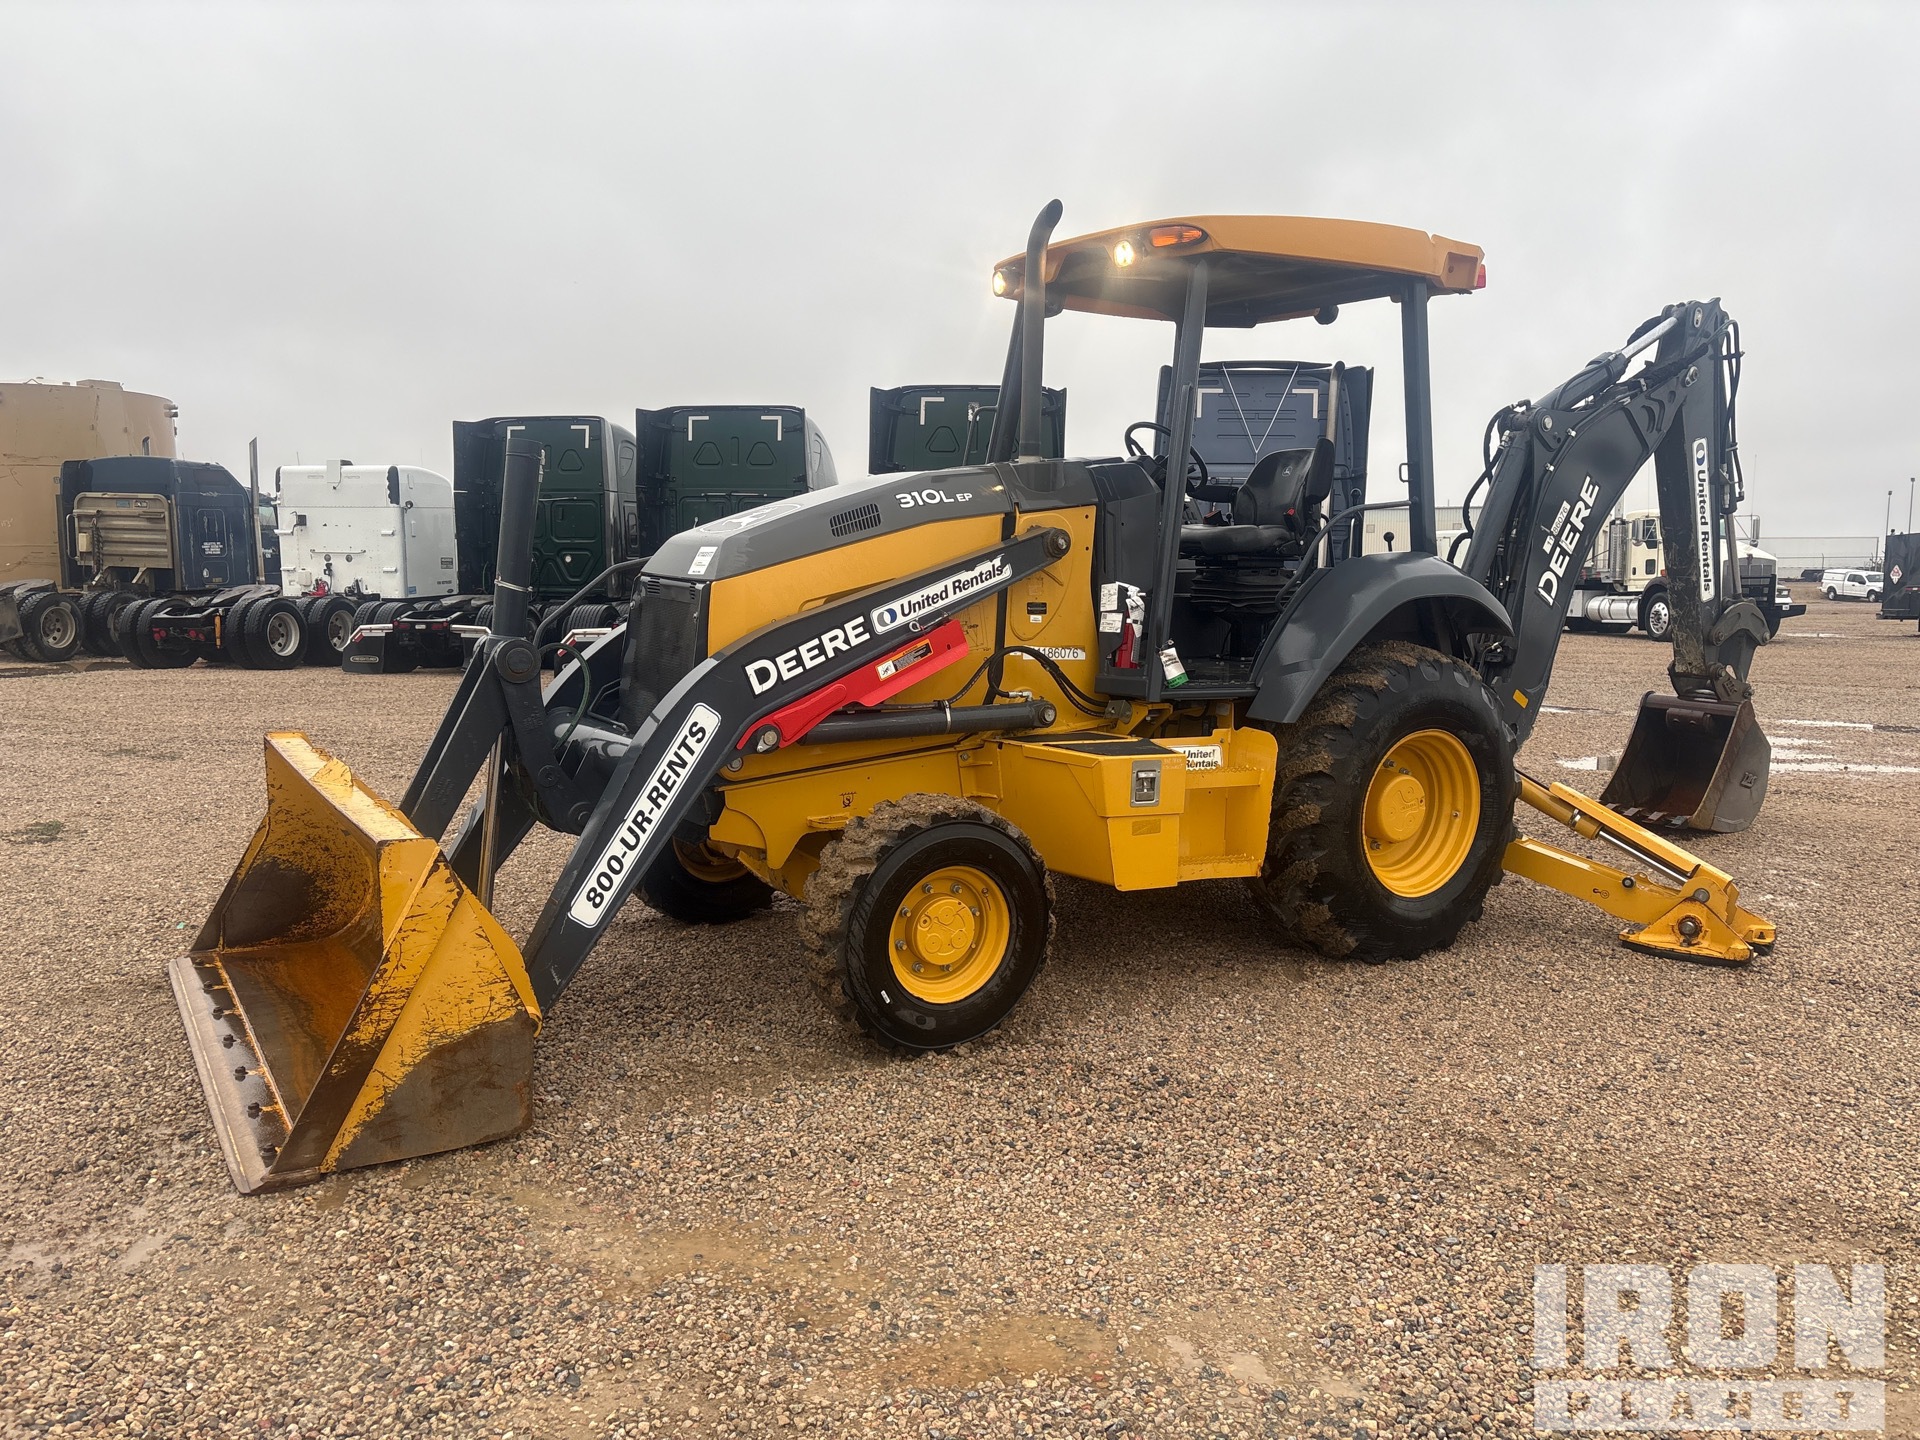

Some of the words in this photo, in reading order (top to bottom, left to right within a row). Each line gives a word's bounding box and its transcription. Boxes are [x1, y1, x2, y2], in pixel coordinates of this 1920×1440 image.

[895, 489, 955, 508] 310L
[956, 493, 973, 502] EP
[1537, 475, 1600, 606] DEERE
[1697, 469, 1709, 526] United
[1700, 531, 1712, 592] Rentals
[744, 615, 871, 696] DEERE
[900, 584, 949, 618] United
[951, 562, 1004, 596] Rentals
[585, 720, 707, 909] 800-UR-RENTS
